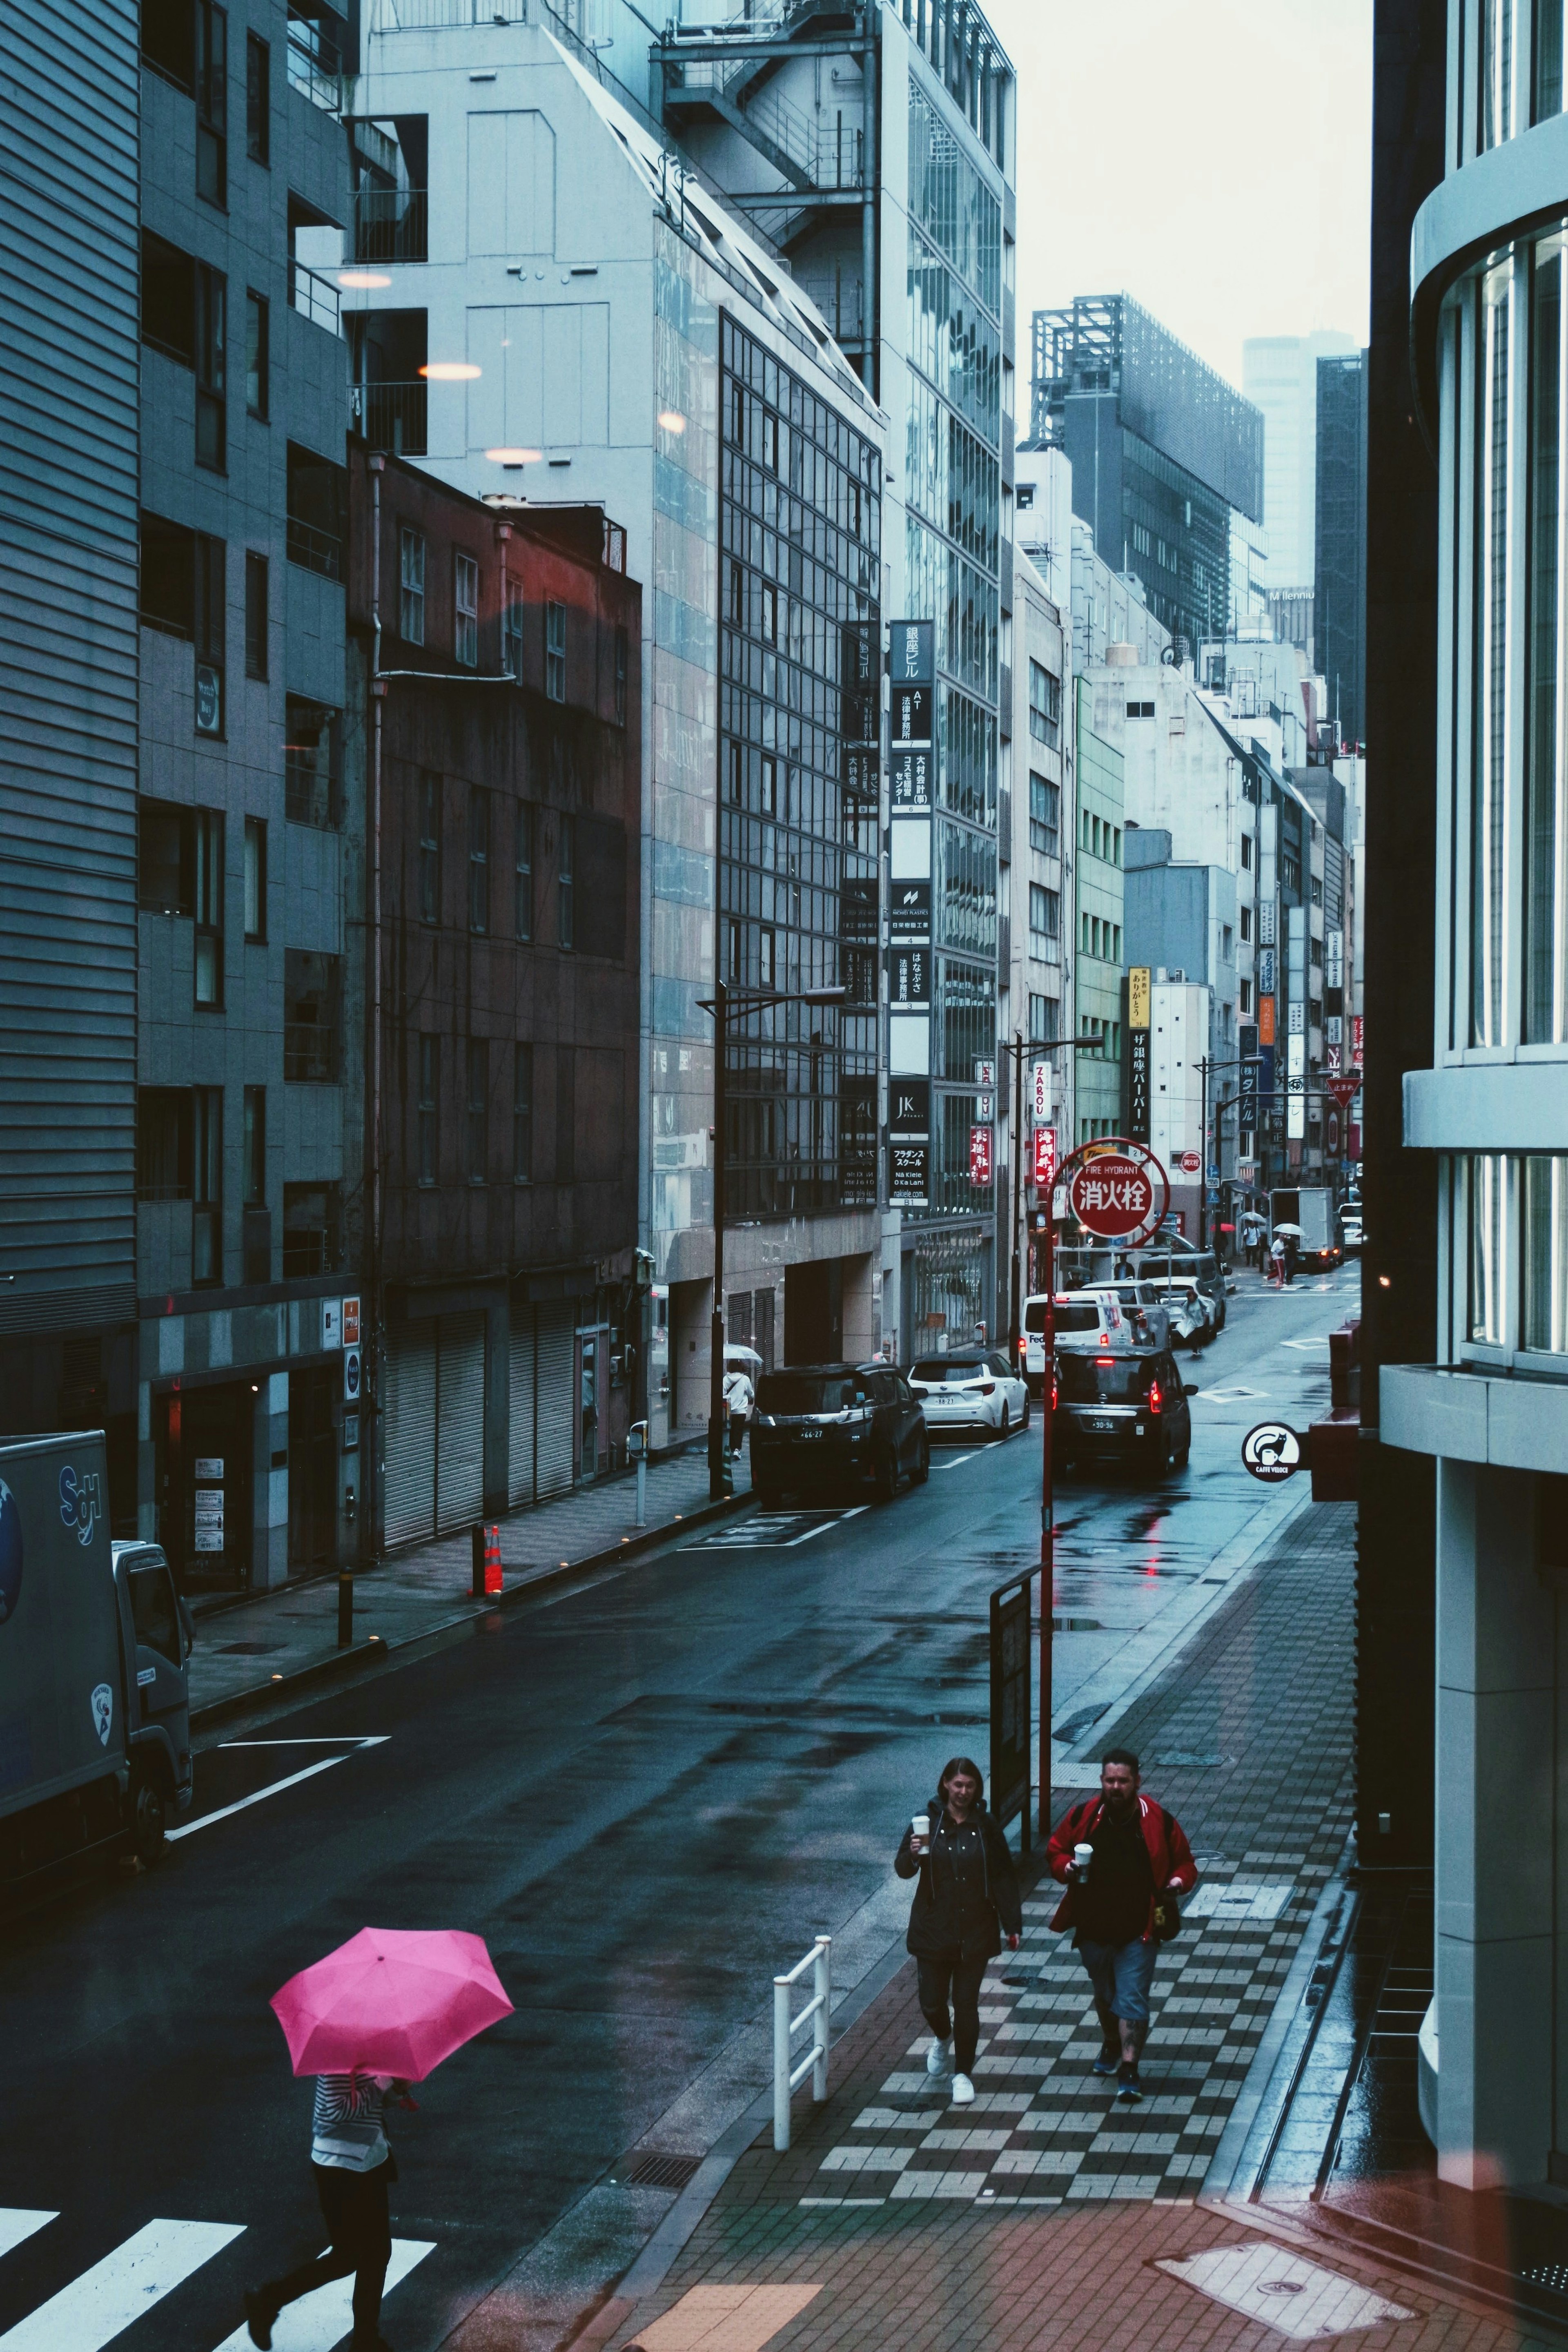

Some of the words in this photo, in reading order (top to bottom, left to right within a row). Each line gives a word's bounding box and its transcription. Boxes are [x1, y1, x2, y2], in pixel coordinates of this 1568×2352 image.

[1270, 591, 1314, 601] Mllenniu
[906, 627, 918, 678] 銀座ビル
[902, 696, 911, 739] 法律事務所
[914, 691, 921, 710] AT
[899, 959, 907, 1001] 法律事務所
[913, 953, 921, 993] はなぶさ
[1133, 1034, 1145, 1119] ザ銀座バーバー
[896, 1097, 913, 1119] JK
[1037, 1130, 1054, 1168] 海鮮丼
[1086, 1166, 1102, 1174] FIRE
[1104, 1166, 1138, 1174] HYDRANT
[894, 1189, 924, 1198] nakiele.com
[1079, 1180, 1146, 1211] 消火栓
